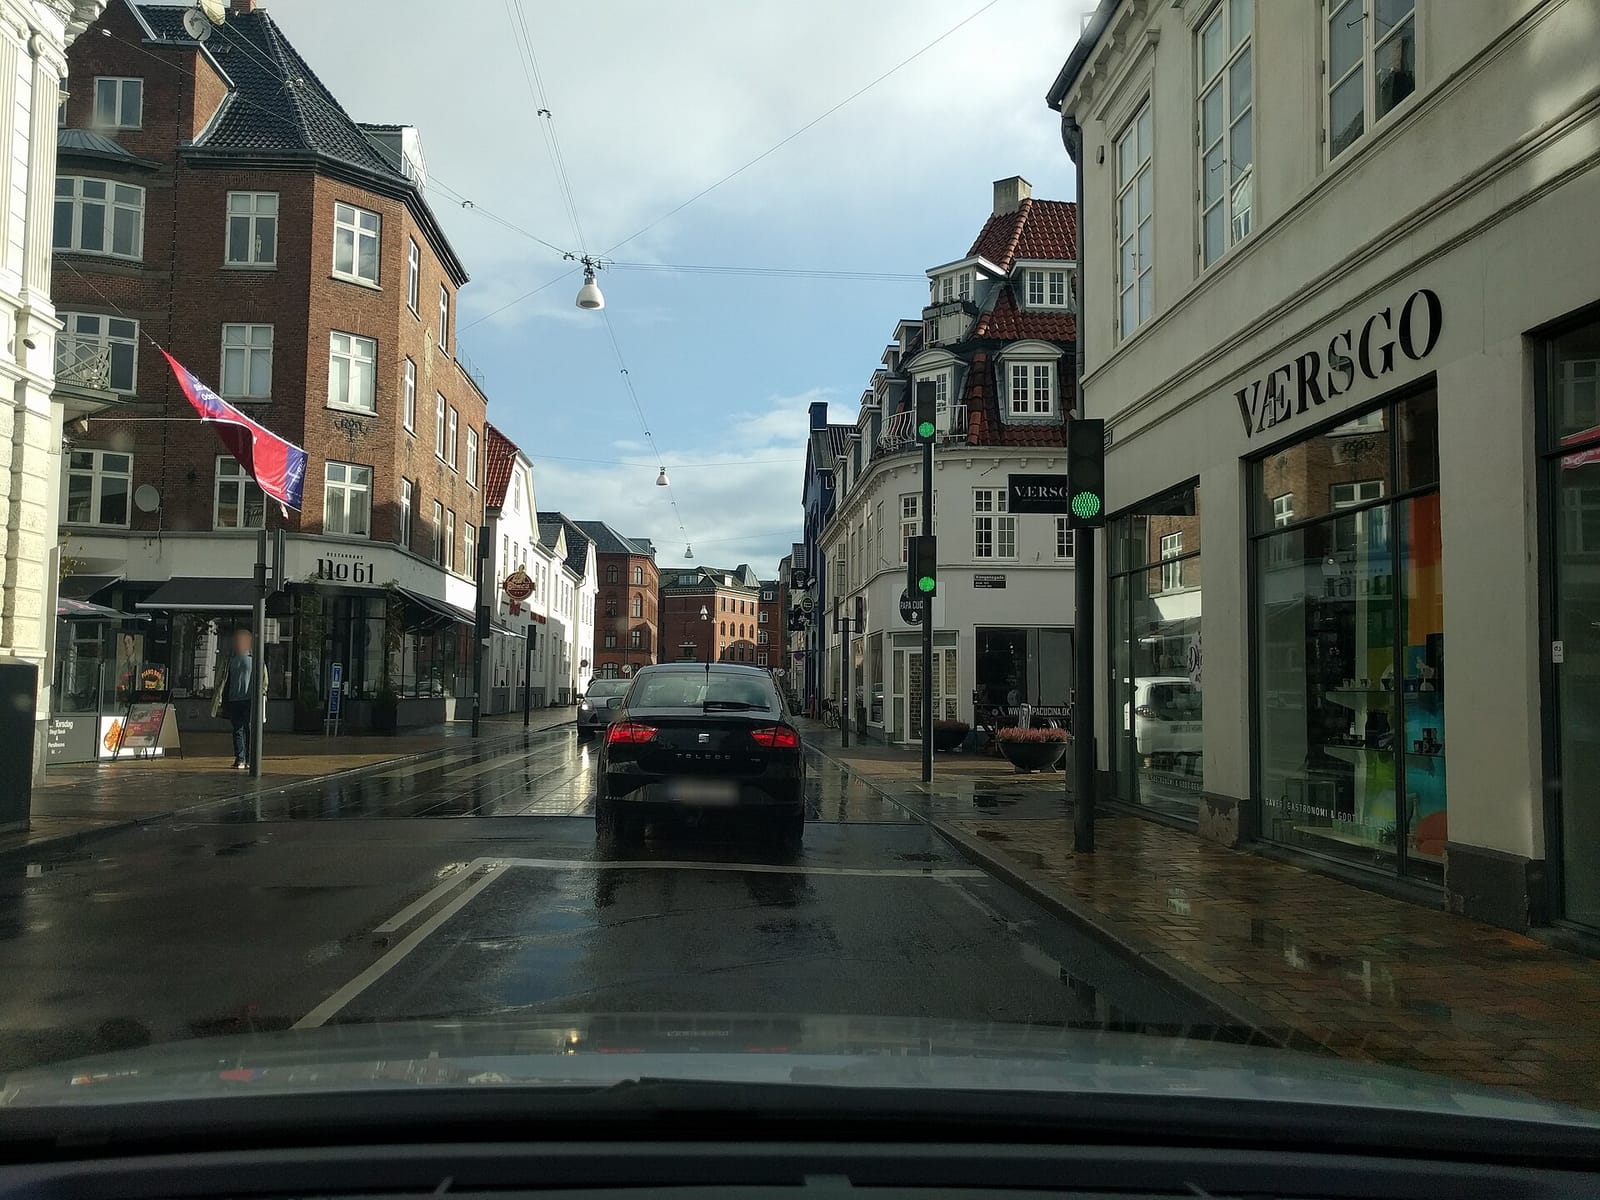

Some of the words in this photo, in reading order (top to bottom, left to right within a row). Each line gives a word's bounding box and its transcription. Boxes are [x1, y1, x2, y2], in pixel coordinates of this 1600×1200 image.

[1234, 288, 1442, 439] VÆRSGO
[353, 562, 374, 584] 61
[55, 719, 74, 730] Torsdag
[1287, 801, 1328, 818] GASTRONOMI
